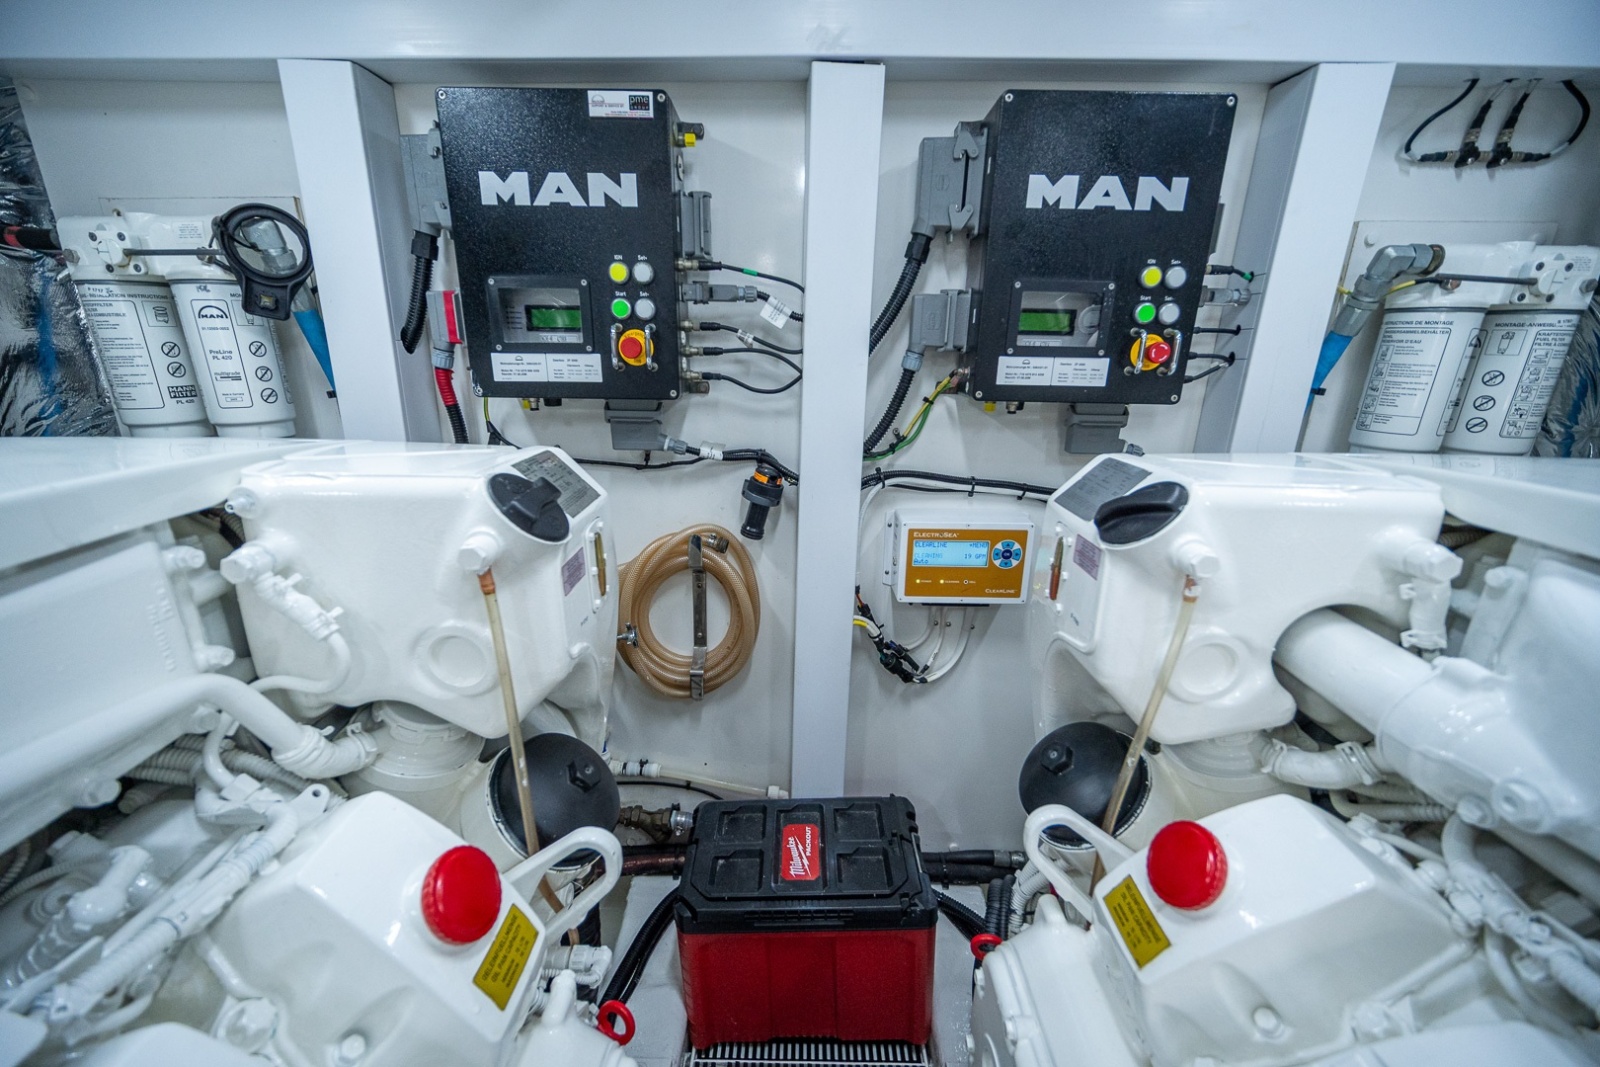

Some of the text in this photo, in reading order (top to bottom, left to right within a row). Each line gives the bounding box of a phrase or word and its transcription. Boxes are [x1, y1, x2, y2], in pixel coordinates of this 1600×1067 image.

[478, 170, 638, 207] MAN
[1026, 174, 1189, 212] MAN
[787, 836, 805, 878] Milwaukee
